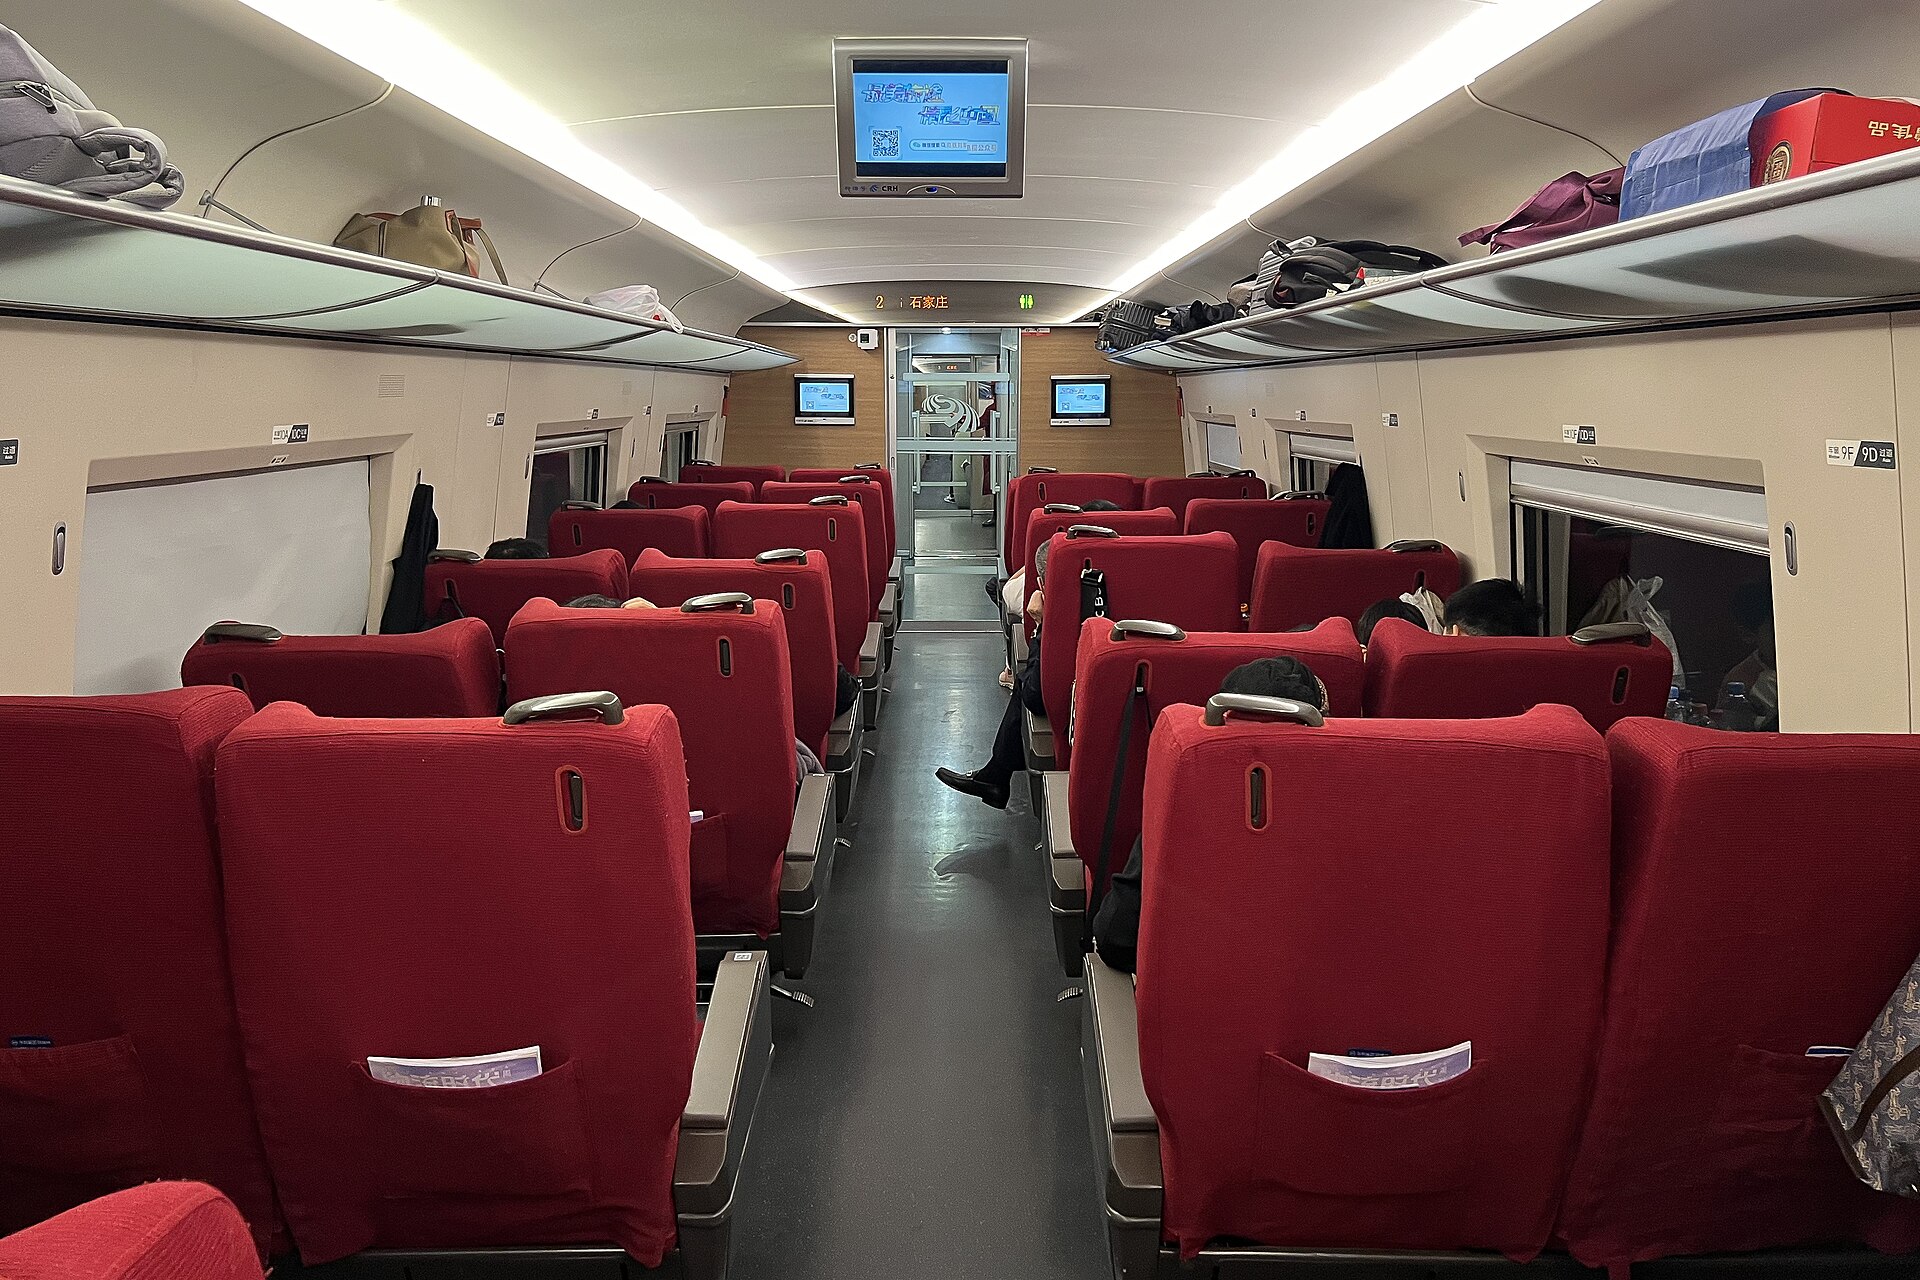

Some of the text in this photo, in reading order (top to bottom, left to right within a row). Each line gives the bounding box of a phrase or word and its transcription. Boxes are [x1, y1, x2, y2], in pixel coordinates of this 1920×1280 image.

[875, 295, 883, 309] 2
[909, 296, 948, 309] 石家庄
[1841, 446, 1854, 460] 9F
[1862, 446, 1878, 462] 9D
